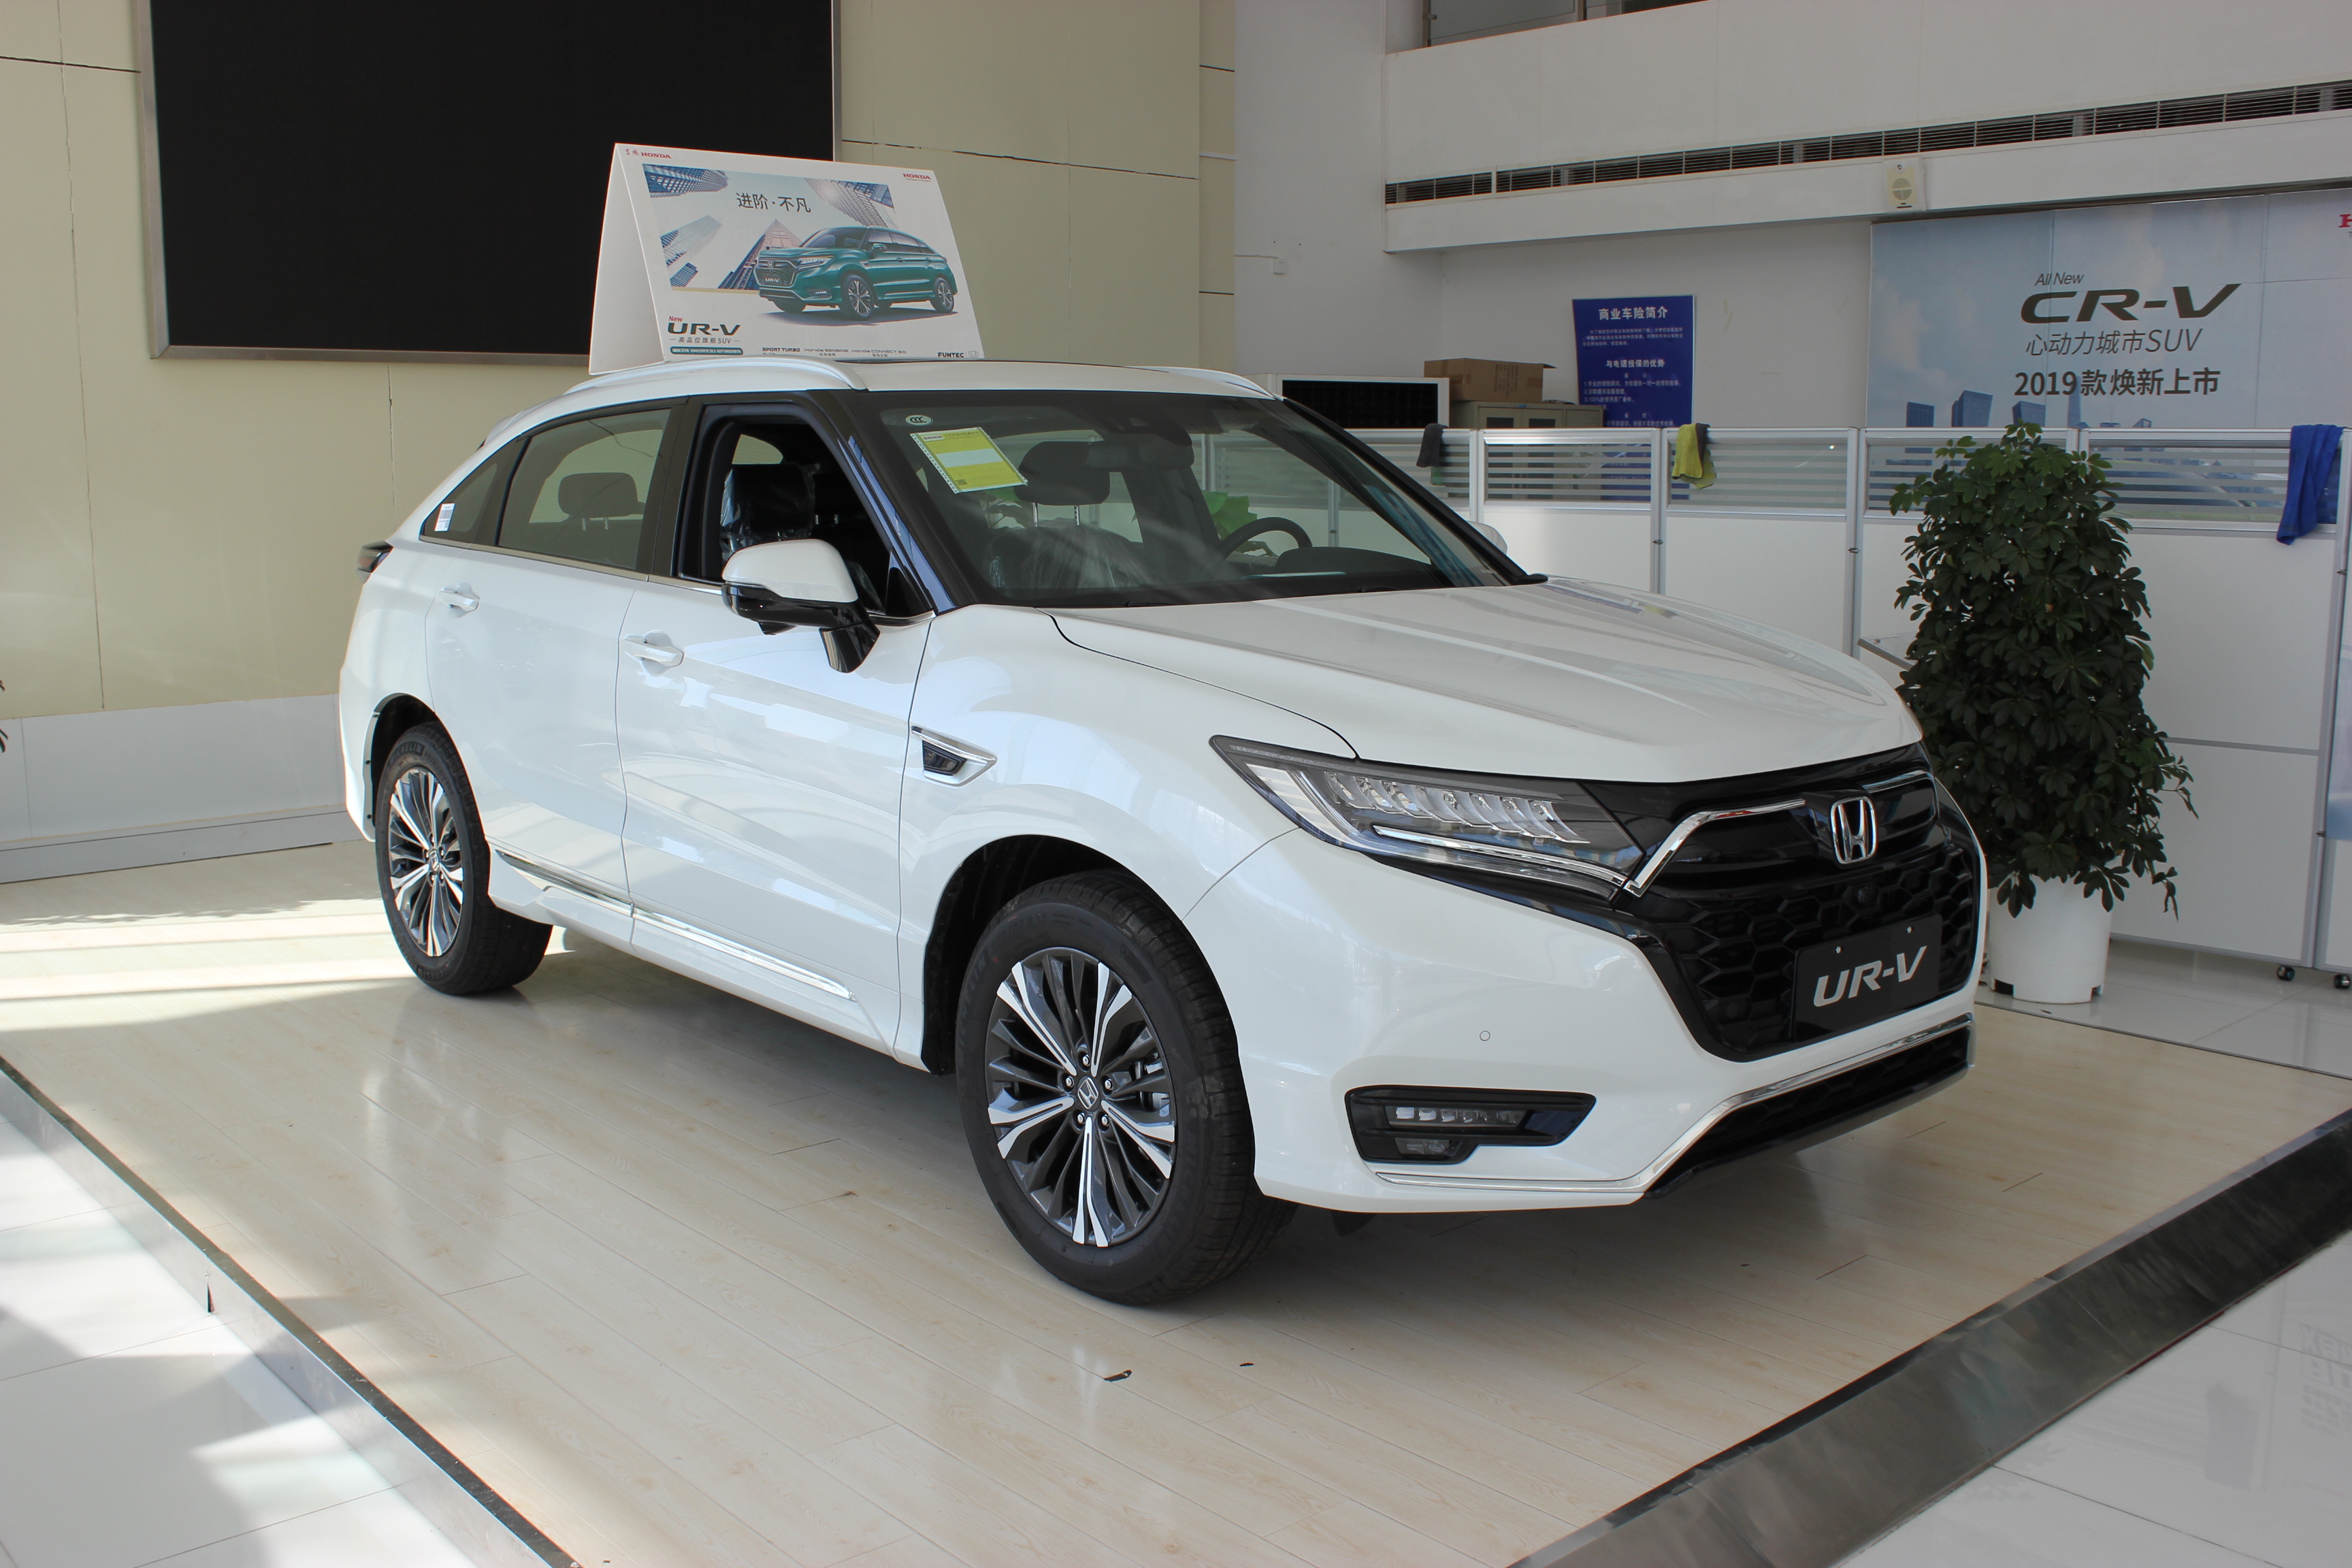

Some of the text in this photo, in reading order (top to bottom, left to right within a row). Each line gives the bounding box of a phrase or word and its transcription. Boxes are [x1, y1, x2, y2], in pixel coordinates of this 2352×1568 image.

[736, 193, 811, 213] 进阶·不凡
[2035, 272, 2085, 286] All New
[1599, 306, 1669, 321] 商业车险简介
[2020, 283, 2242, 324] CR-V
[668, 322, 741, 336] UR-V
[2025, 327, 2204, 357] 心动力城市SUV
[1605, 359, 1665, 368] 与电话投保的优势
[2014, 368, 2221, 397] 2019款焕新上市
[1813, 945, 1927, 1007] UR-V
